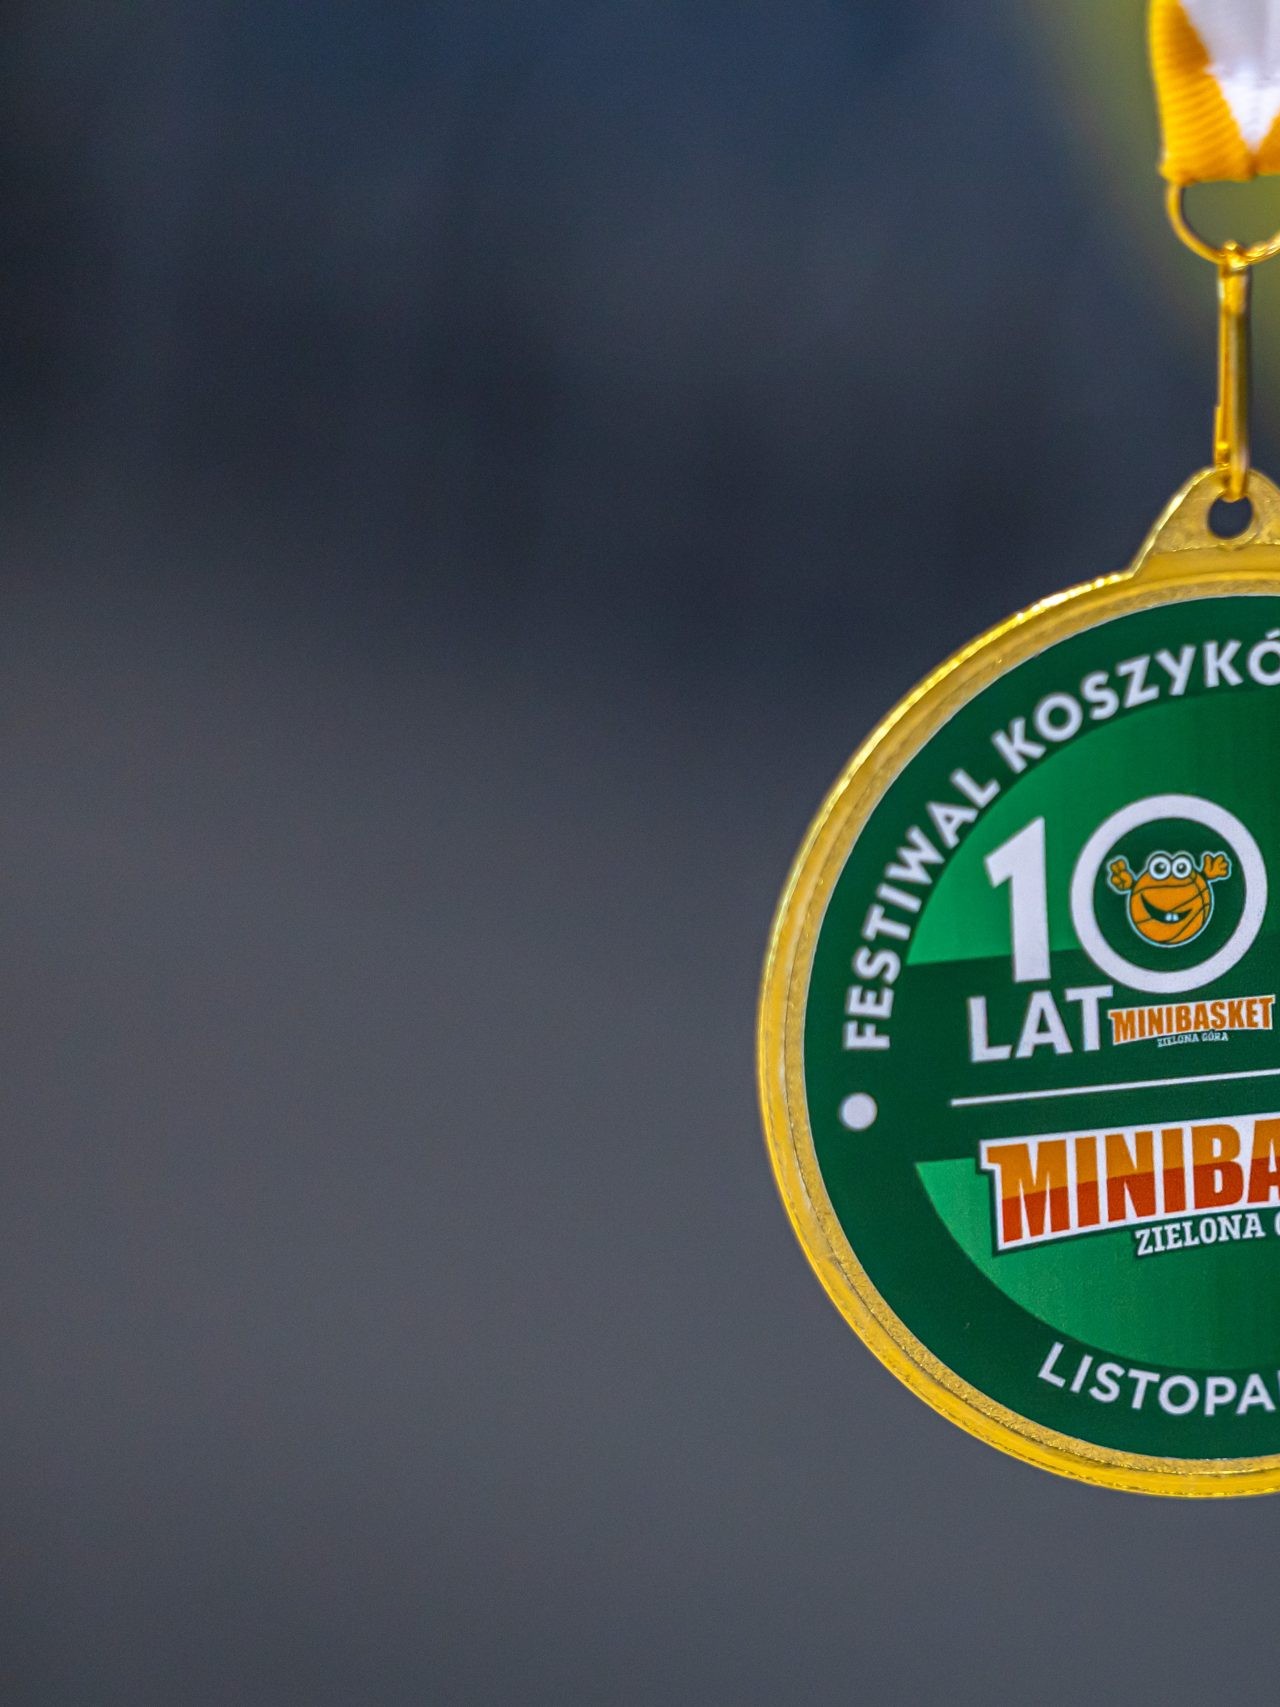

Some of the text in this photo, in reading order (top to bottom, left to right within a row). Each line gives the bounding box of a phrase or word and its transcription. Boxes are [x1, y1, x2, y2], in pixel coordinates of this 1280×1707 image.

[843, 768, 1000, 1051] FESTIWAL
[984, 794, 1268, 994] 10
[967, 985, 1114, 1064] LAT
[1109, 996, 1275, 1044] MINIBASKET
[1135, 1211, 1266, 1257] ZIELONA
